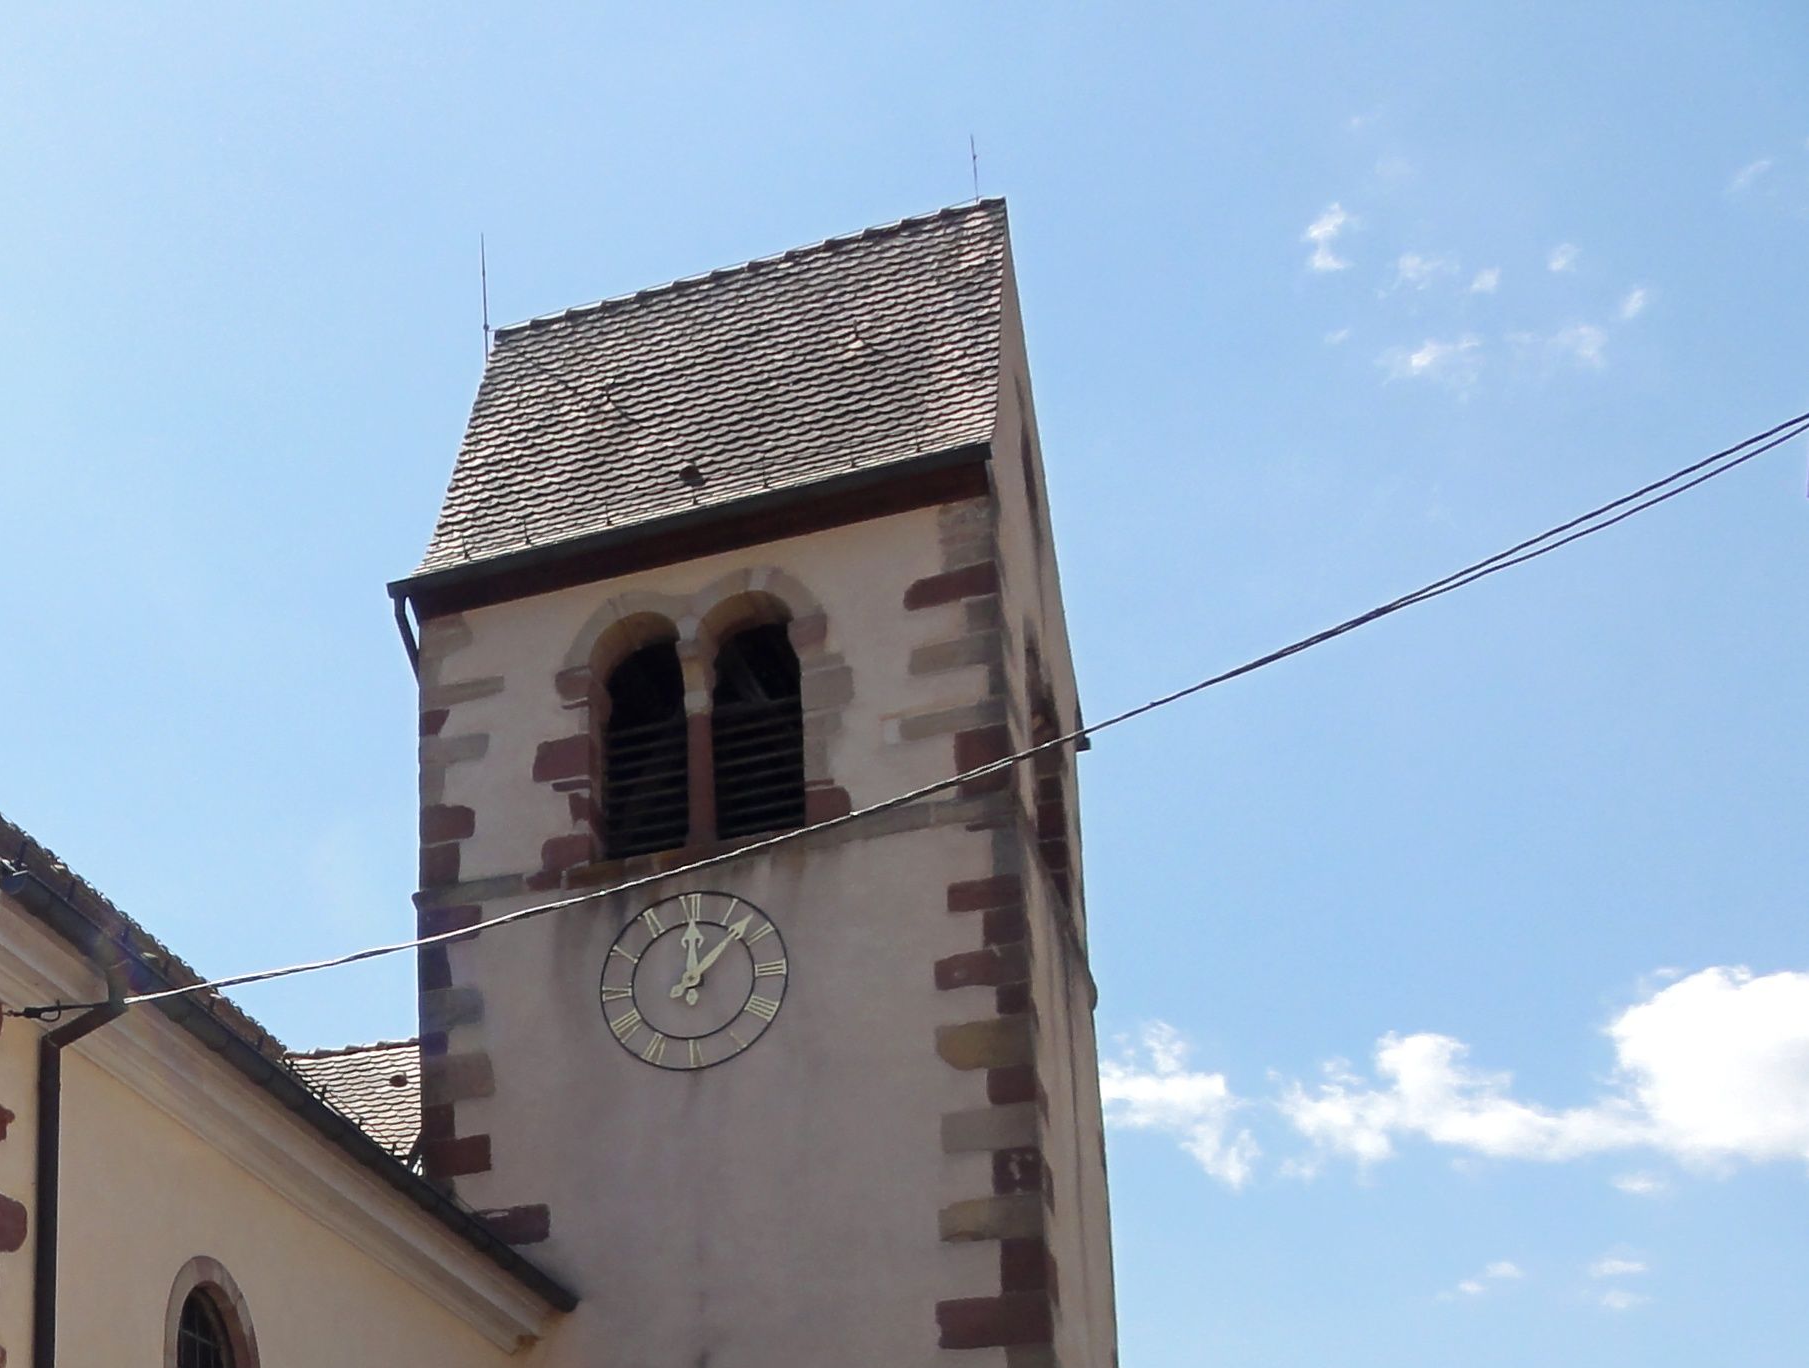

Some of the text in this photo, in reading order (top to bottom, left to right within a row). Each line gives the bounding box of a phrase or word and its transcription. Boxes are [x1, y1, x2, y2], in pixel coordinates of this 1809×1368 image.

[720, 898, 738, 925] I
[746, 922, 774, 945] II
[755, 958, 787, 977] III
[744, 995, 779, 1022] IIII
